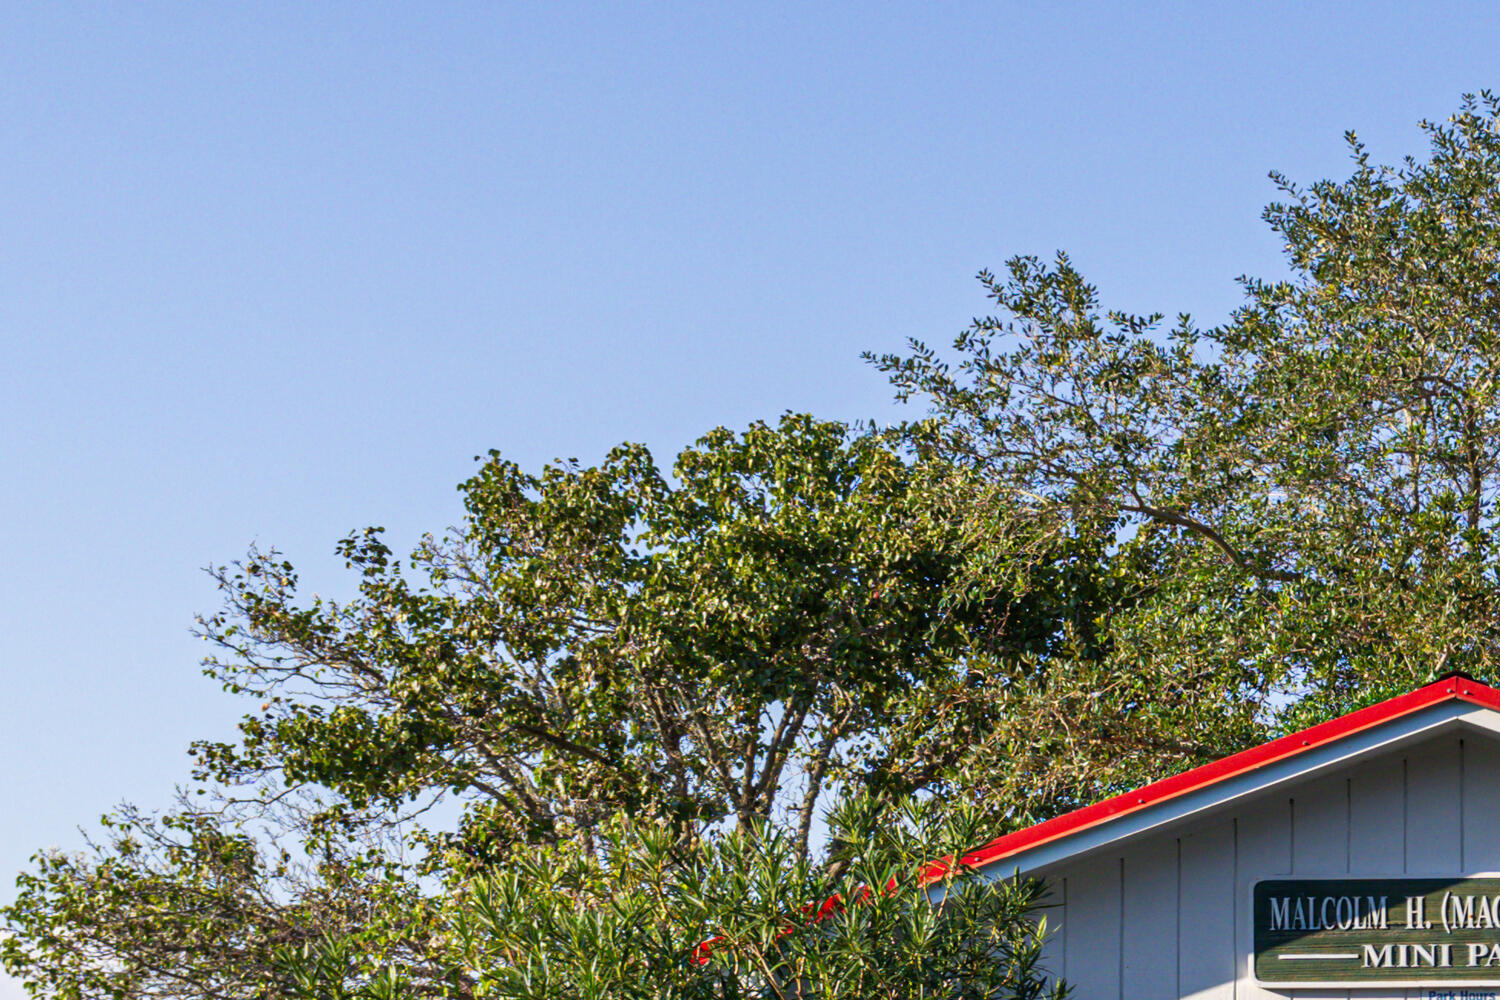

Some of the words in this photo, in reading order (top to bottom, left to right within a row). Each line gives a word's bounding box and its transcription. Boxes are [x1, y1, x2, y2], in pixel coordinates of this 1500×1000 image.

[1269, 895, 1388, 931] MALCOLM
[1404, 895, 1432, 931] H.
[1361, 942, 1453, 969] MINI
